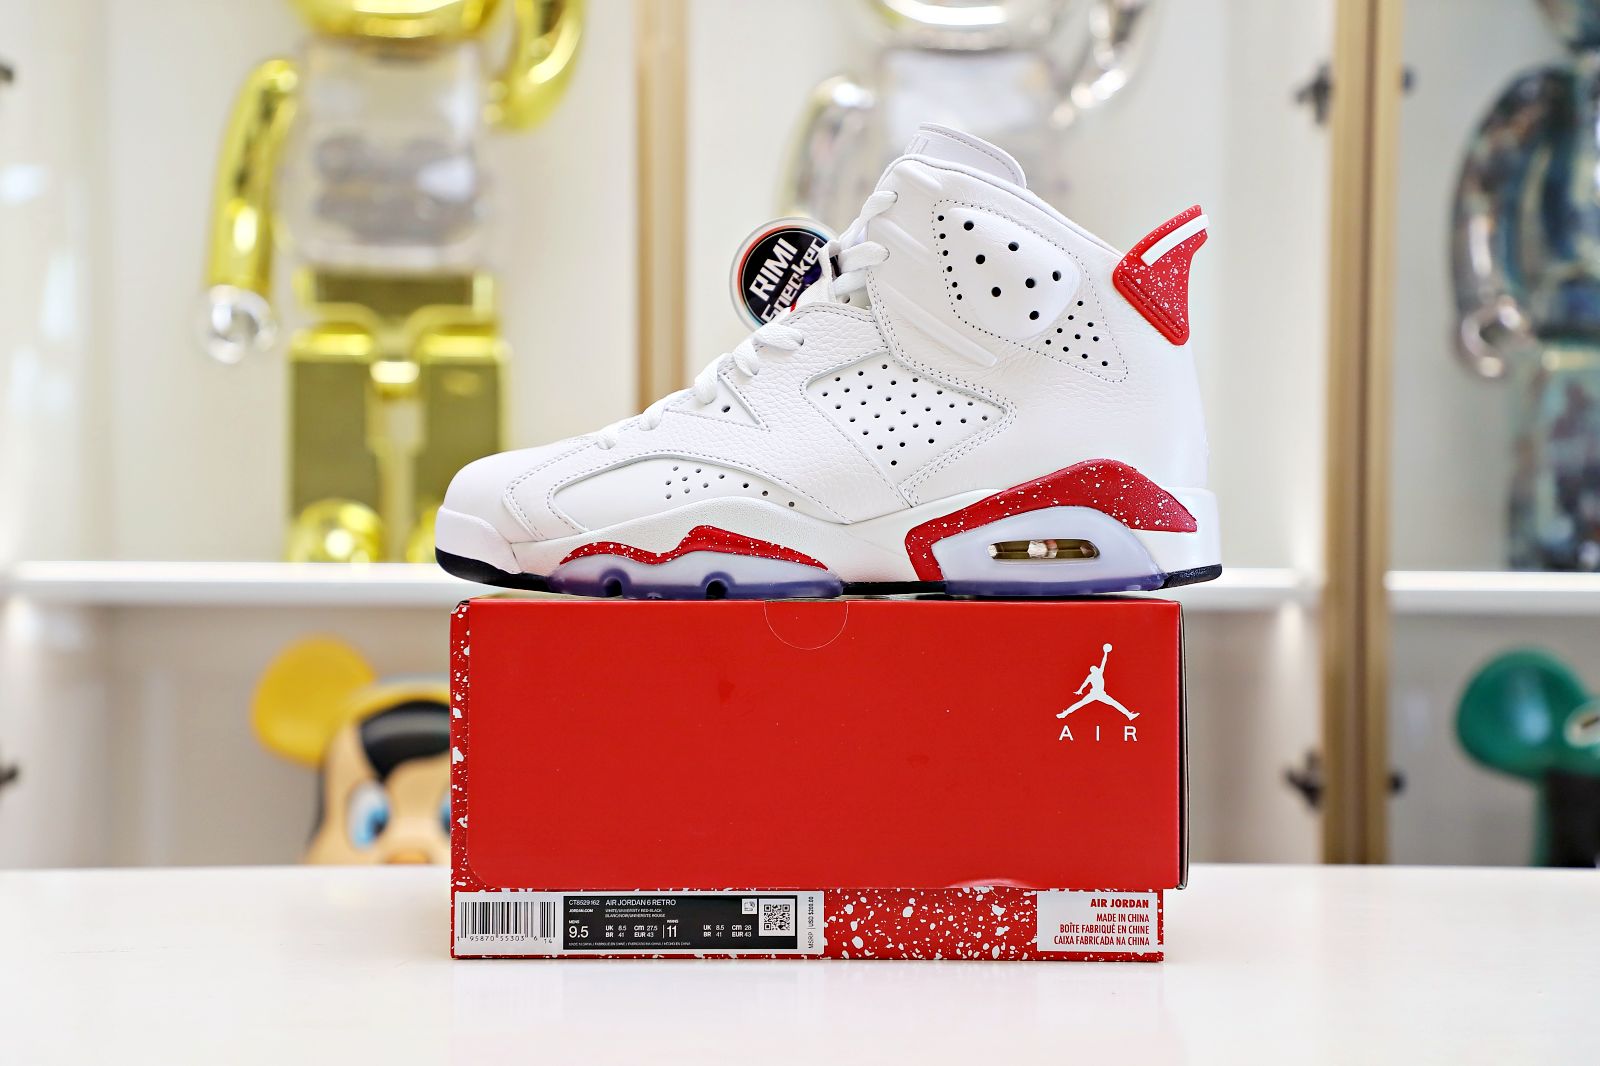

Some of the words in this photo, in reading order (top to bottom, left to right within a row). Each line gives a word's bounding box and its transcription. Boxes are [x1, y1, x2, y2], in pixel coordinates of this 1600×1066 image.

[749, 237, 798, 302] RIMI
[1059, 725, 1137, 741] AIR
[1090, 898, 1108, 908] AIR
[1110, 899, 1149, 908] JORDAN
[1096, 913, 1116, 922] MADE
[1118, 913, 1126, 922] IN
[1127, 913, 1149, 922] CHINA
[568, 925, 589, 938] 9.5
[667, 925, 677, 938] 11
[1060, 922, 1079, 933] BOÎTE
[1081, 923, 1116, 934] FABRIQUÉ
[1117, 925, 1127, 934] EN
[1128, 925, 1149, 934] CHINE
[1054, 935, 1074, 945] CAIXA
[1075, 935, 1115, 945] FABRICADA
[1116, 936, 1126, 945] NA
[1127, 936, 1150, 946] CHINA
